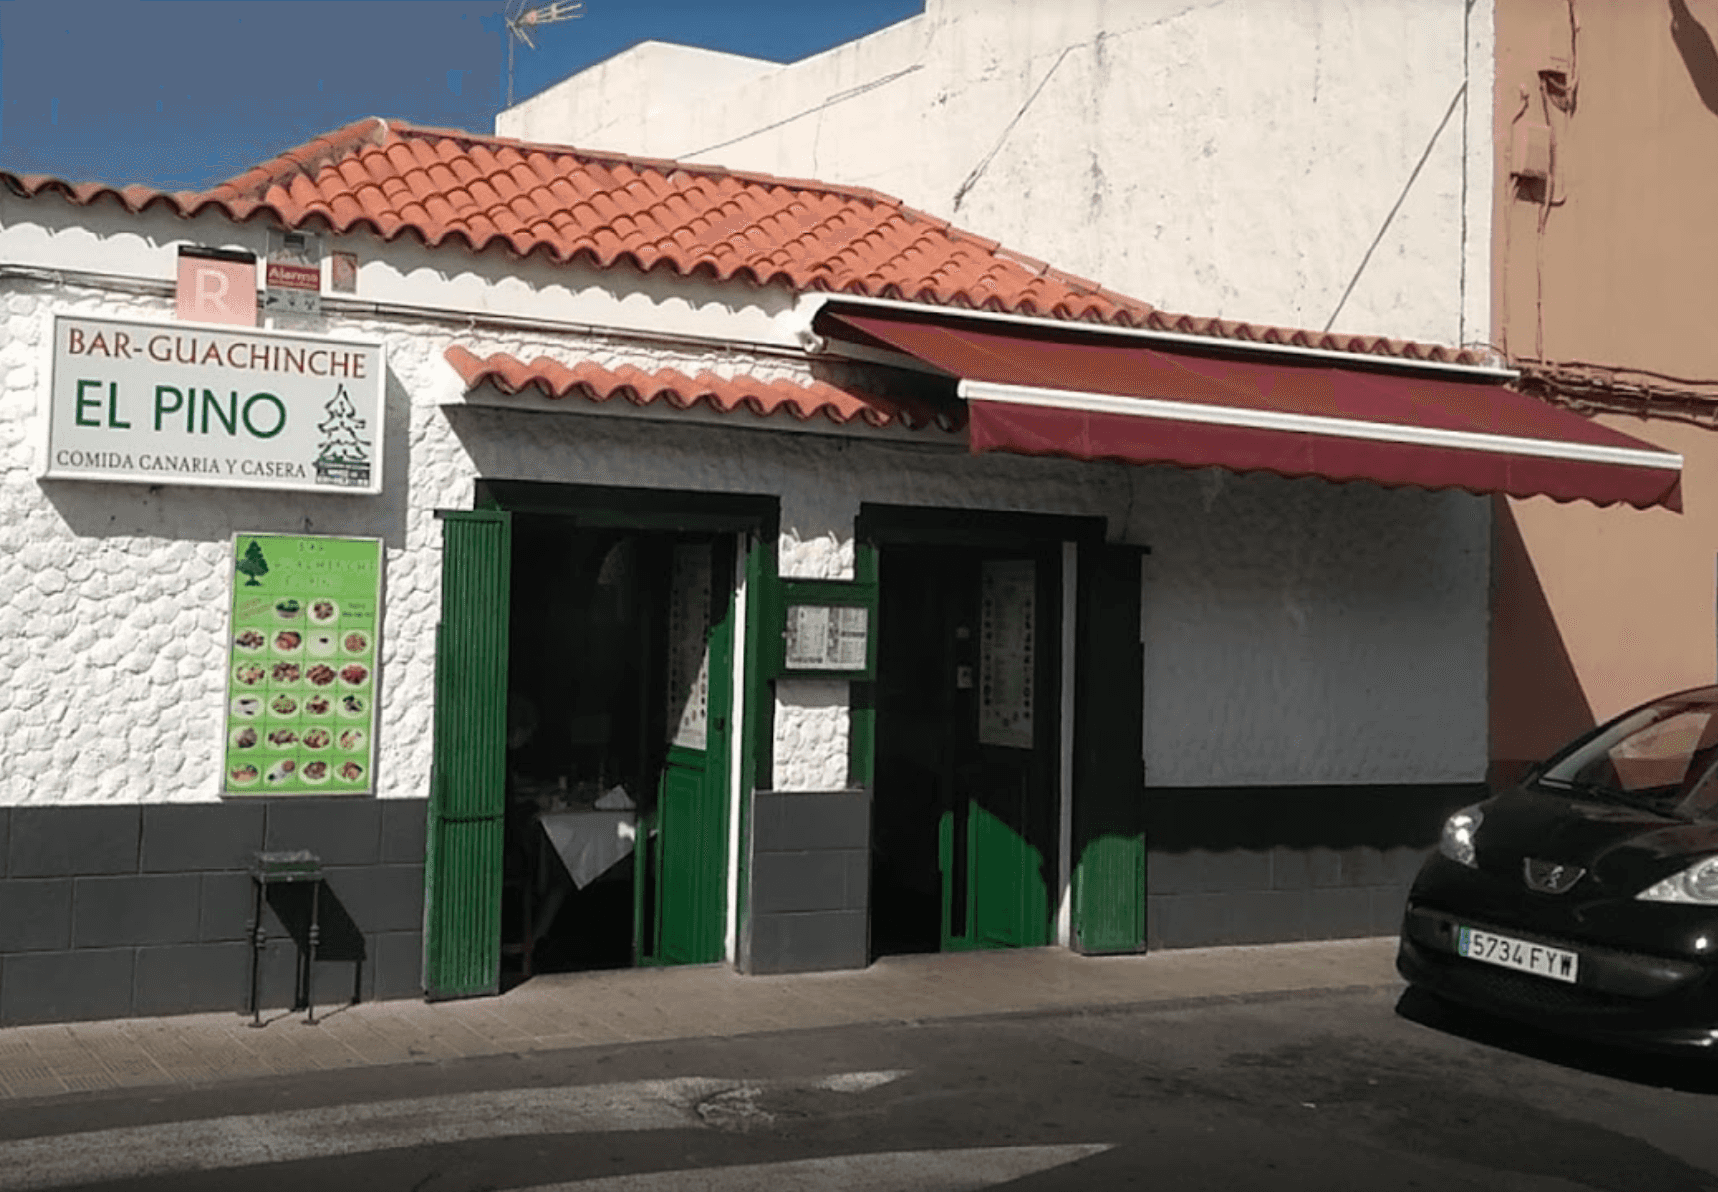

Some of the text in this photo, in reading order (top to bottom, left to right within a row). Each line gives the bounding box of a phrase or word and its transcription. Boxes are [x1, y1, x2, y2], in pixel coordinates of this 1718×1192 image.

[196, 268, 230, 312] R
[269, 266, 319, 283] Alarma
[69, 327, 367, 379] BAR-GUACHINCHE
[75, 379, 287, 439] EL PINO
[57, 449, 307, 479] COMIDA CANARIA Y CASERA
[1473, 933, 1573, 978] 5734 FYW
